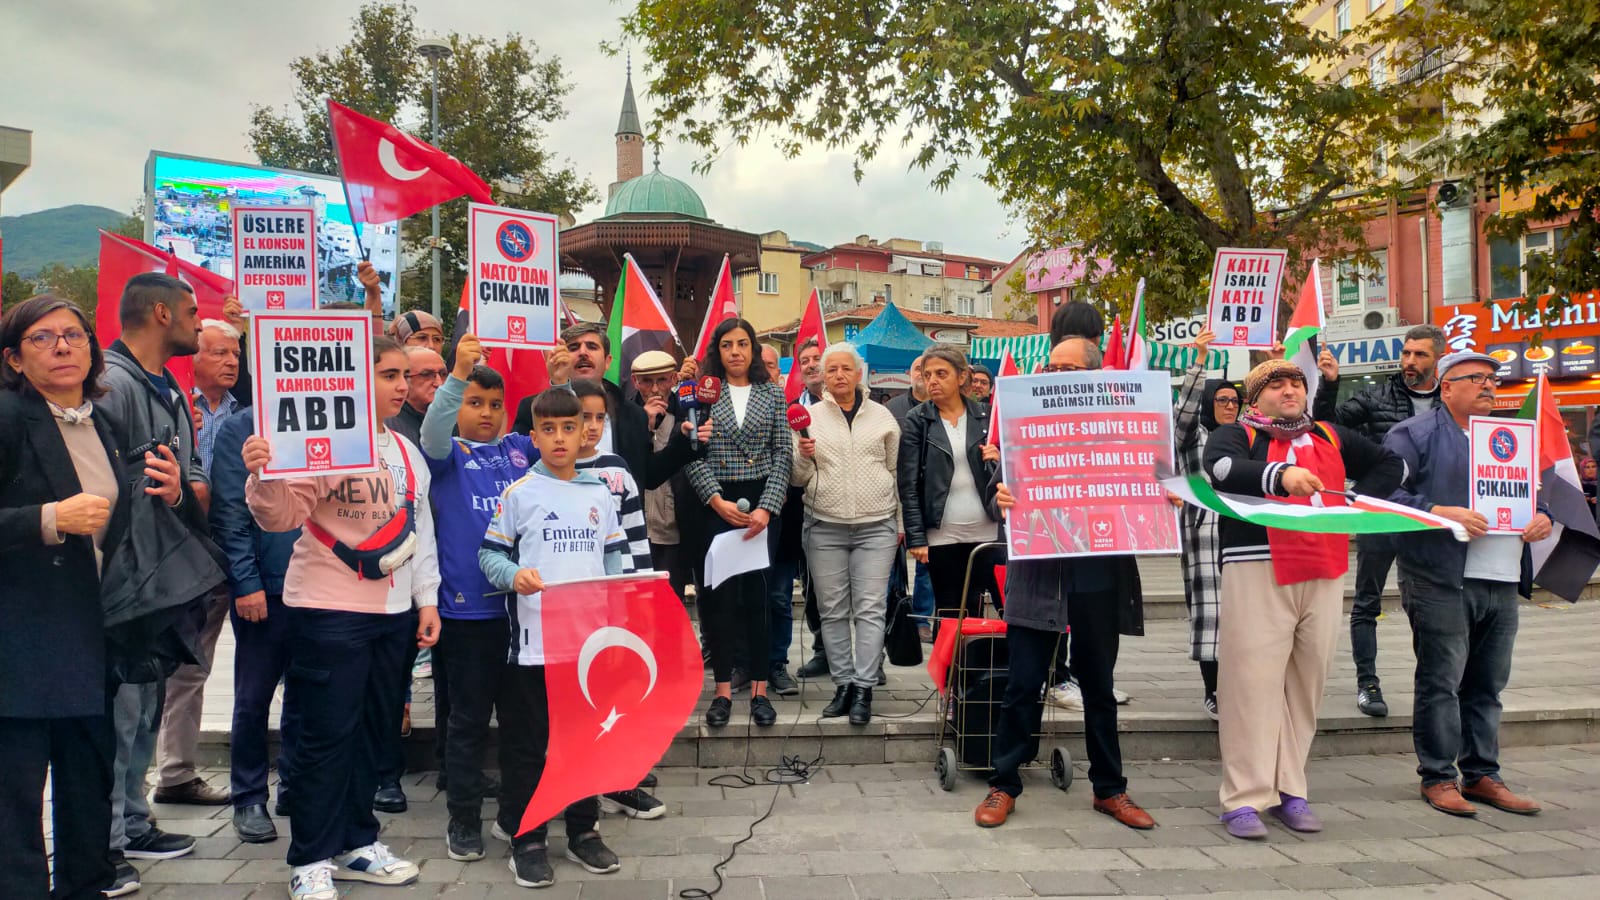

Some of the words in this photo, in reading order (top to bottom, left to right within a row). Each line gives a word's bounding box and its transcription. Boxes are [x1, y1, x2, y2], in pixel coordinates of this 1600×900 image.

[243, 214, 305, 234] ÜSLERE
[243, 237, 255, 250] EL
[258, 237, 305, 250] KONSUN
[244, 252, 306, 270] AMERİKA
[1227, 256, 1270, 273] KATİL
[244, 273, 307, 286] DEFOLSUN!
[480, 262, 548, 286] NATO'DAN
[1224, 272, 1267, 287] İSRAİL
[480, 281, 549, 307] ÇIKALIM
[1221, 287, 1264, 305] KATİL
[1221, 305, 1262, 322] ABD
[274, 327, 353, 342] KAHROLSUN
[274, 341, 356, 373] İSRAİL
[276, 377, 355, 393] KAHROLSUN
[1032, 383, 1094, 397] KAHROLSUN
[1097, 382, 1142, 393] SİYONİZM
[1042, 396, 1094, 409] BAĞIMSIZ
[1096, 394, 1136, 407] FİLİSTİN
[277, 395, 356, 433] ABD
[1020, 418, 1124, 440] TÜRKİYE-SURİYE
[1127, 421, 1139, 435] EL
[1142, 420, 1158, 434] ELE
[1030, 451, 1121, 470] TÜRKİYE-İRAN
[1123, 452, 1136, 465] EL
[1138, 452, 1154, 465] ELE
[1477, 464, 1528, 481] NATO'DAN
[1027, 483, 1129, 502] TÜRKİYE-RUSYA
[1131, 483, 1143, 497] EL
[1145, 483, 1161, 496] ELE
[1477, 479, 1529, 500] ÇIKALIM
[337, 508, 367, 519] ENJOY
[553, 541, 567, 553] FLY
[569, 541, 595, 553] BETTER
